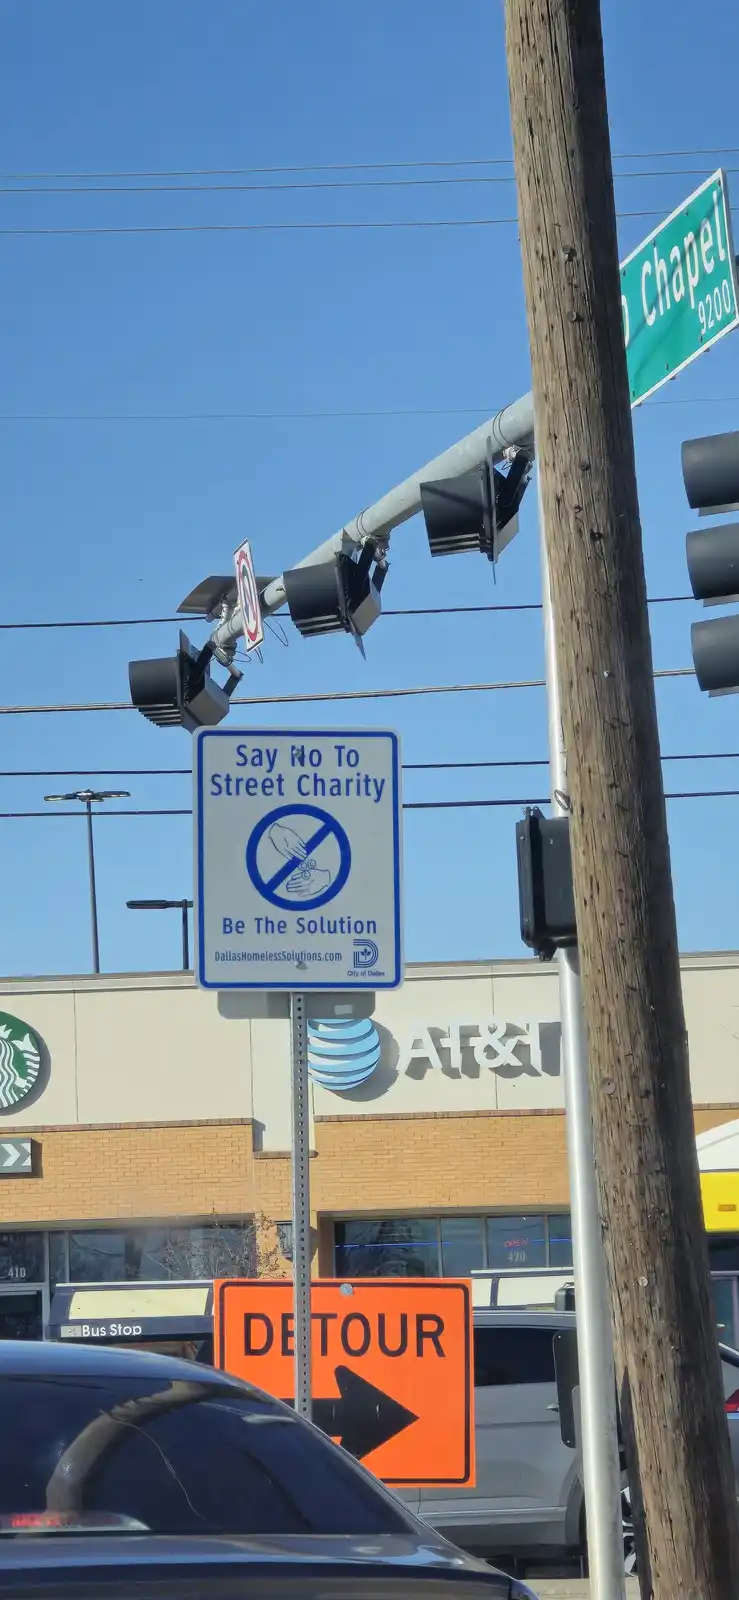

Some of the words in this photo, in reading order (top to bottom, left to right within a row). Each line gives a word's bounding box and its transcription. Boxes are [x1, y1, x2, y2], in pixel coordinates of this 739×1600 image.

[640, 189, 726, 326] Chapel
[698, 279, 731, 335] 9200
[235, 744, 278, 773] Say
[290, 745, 323, 767] No
[334, 745, 360, 768] To
[210, 773, 285, 797] Street
[297, 773, 385, 803] Charity
[222, 917, 245, 934] Be
[254, 917, 287, 934] The
[296, 917, 377, 934] Solution
[214, 950, 343, 963] DallasHomelessSolutions.com
[347, 970, 360, 978] City
[398, 1015, 562, 1069] AT&T
[507, 1251, 526, 1262] 420
[8, 1267, 26, 1278] 410
[82, 1324, 106, 1337] Bus
[109, 1323, 143, 1337] Stop
[243, 1312, 446, 1358] DETOUR
